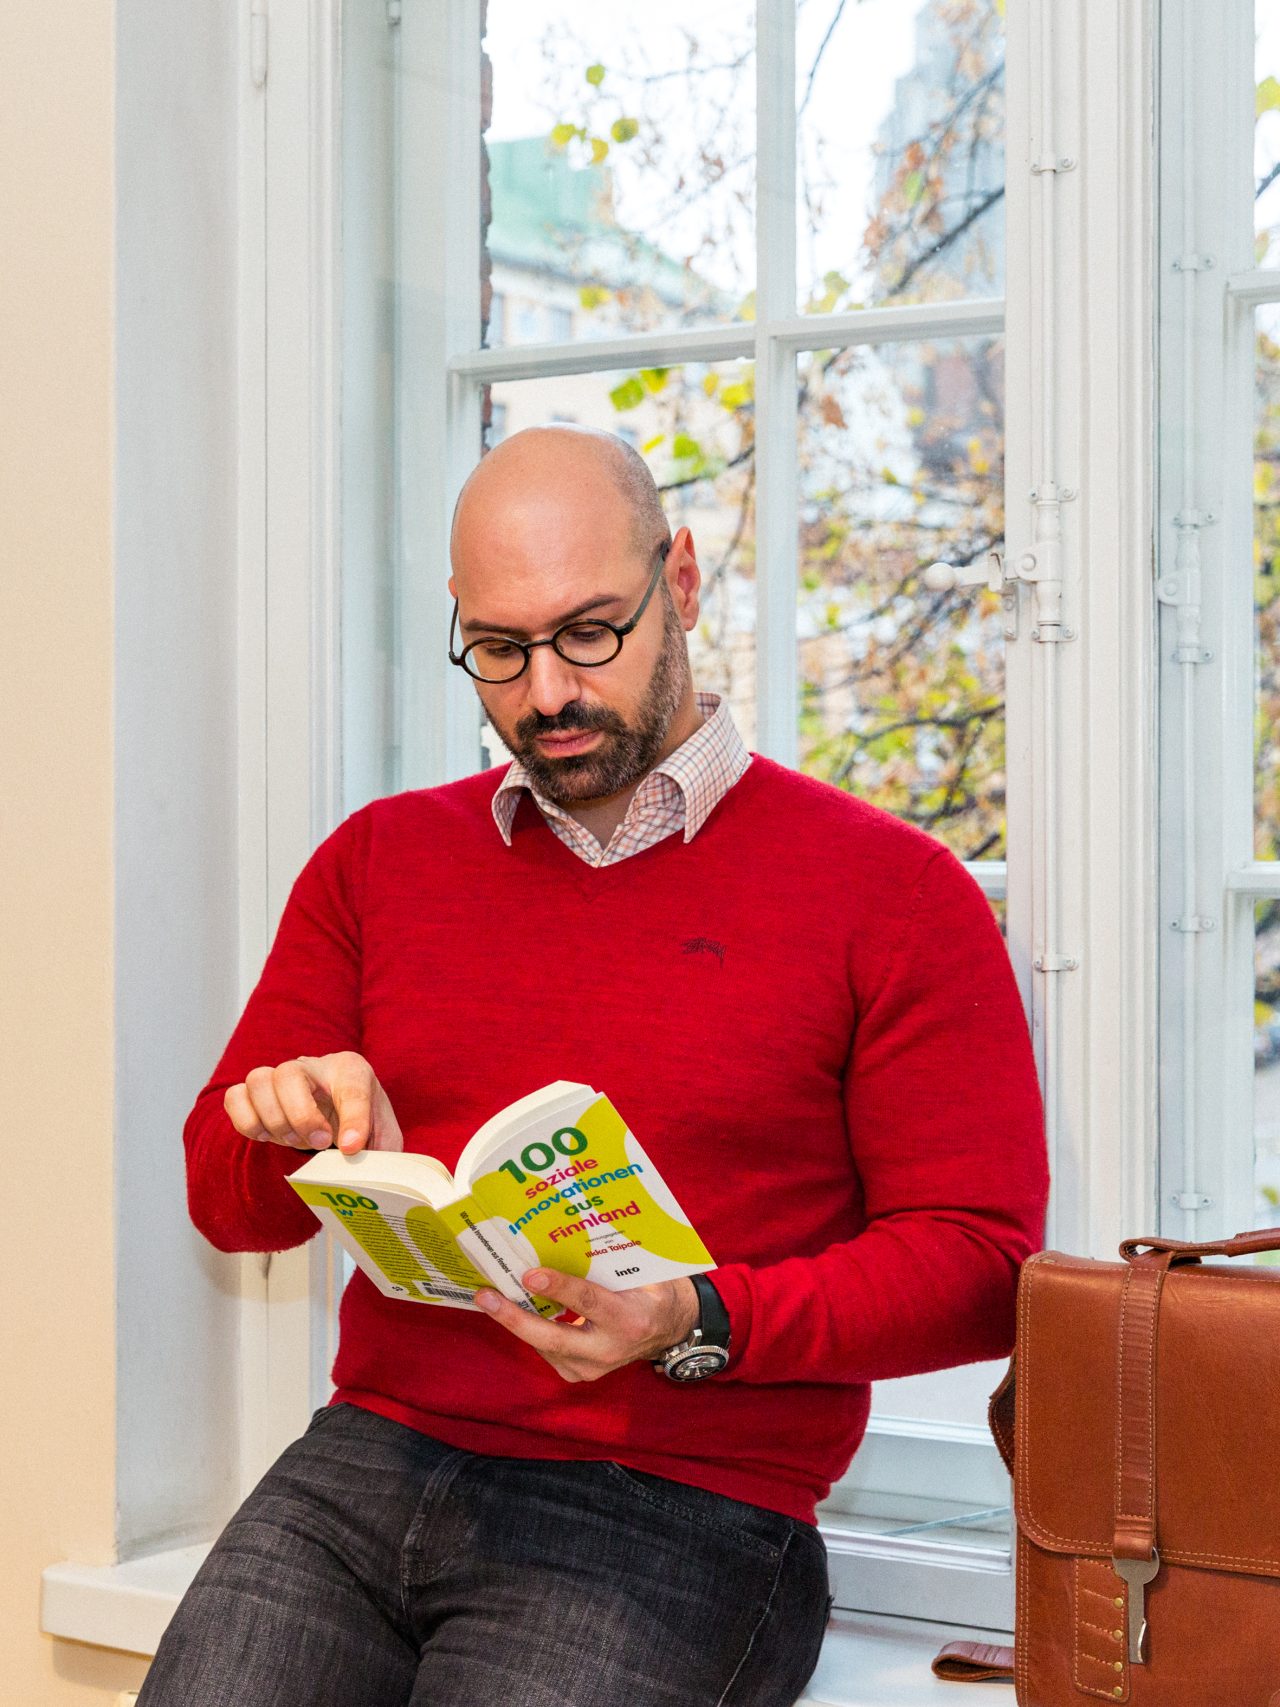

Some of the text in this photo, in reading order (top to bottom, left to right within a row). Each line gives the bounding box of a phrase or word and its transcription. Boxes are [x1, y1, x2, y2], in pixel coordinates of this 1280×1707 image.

[499, 1127, 588, 1184] 100
[525, 1158, 598, 1199] soziale
[320, 1191, 379, 1211] 100
[508, 1163, 643, 1235] Innovationen
[564, 1196, 604, 1216] aus
[549, 1201, 641, 1243] Finnland
[585, 1239, 642, 1259] Ilkka Taipale
[497, 1258, 511, 1274] Finnland
[615, 1266, 640, 1277] into
